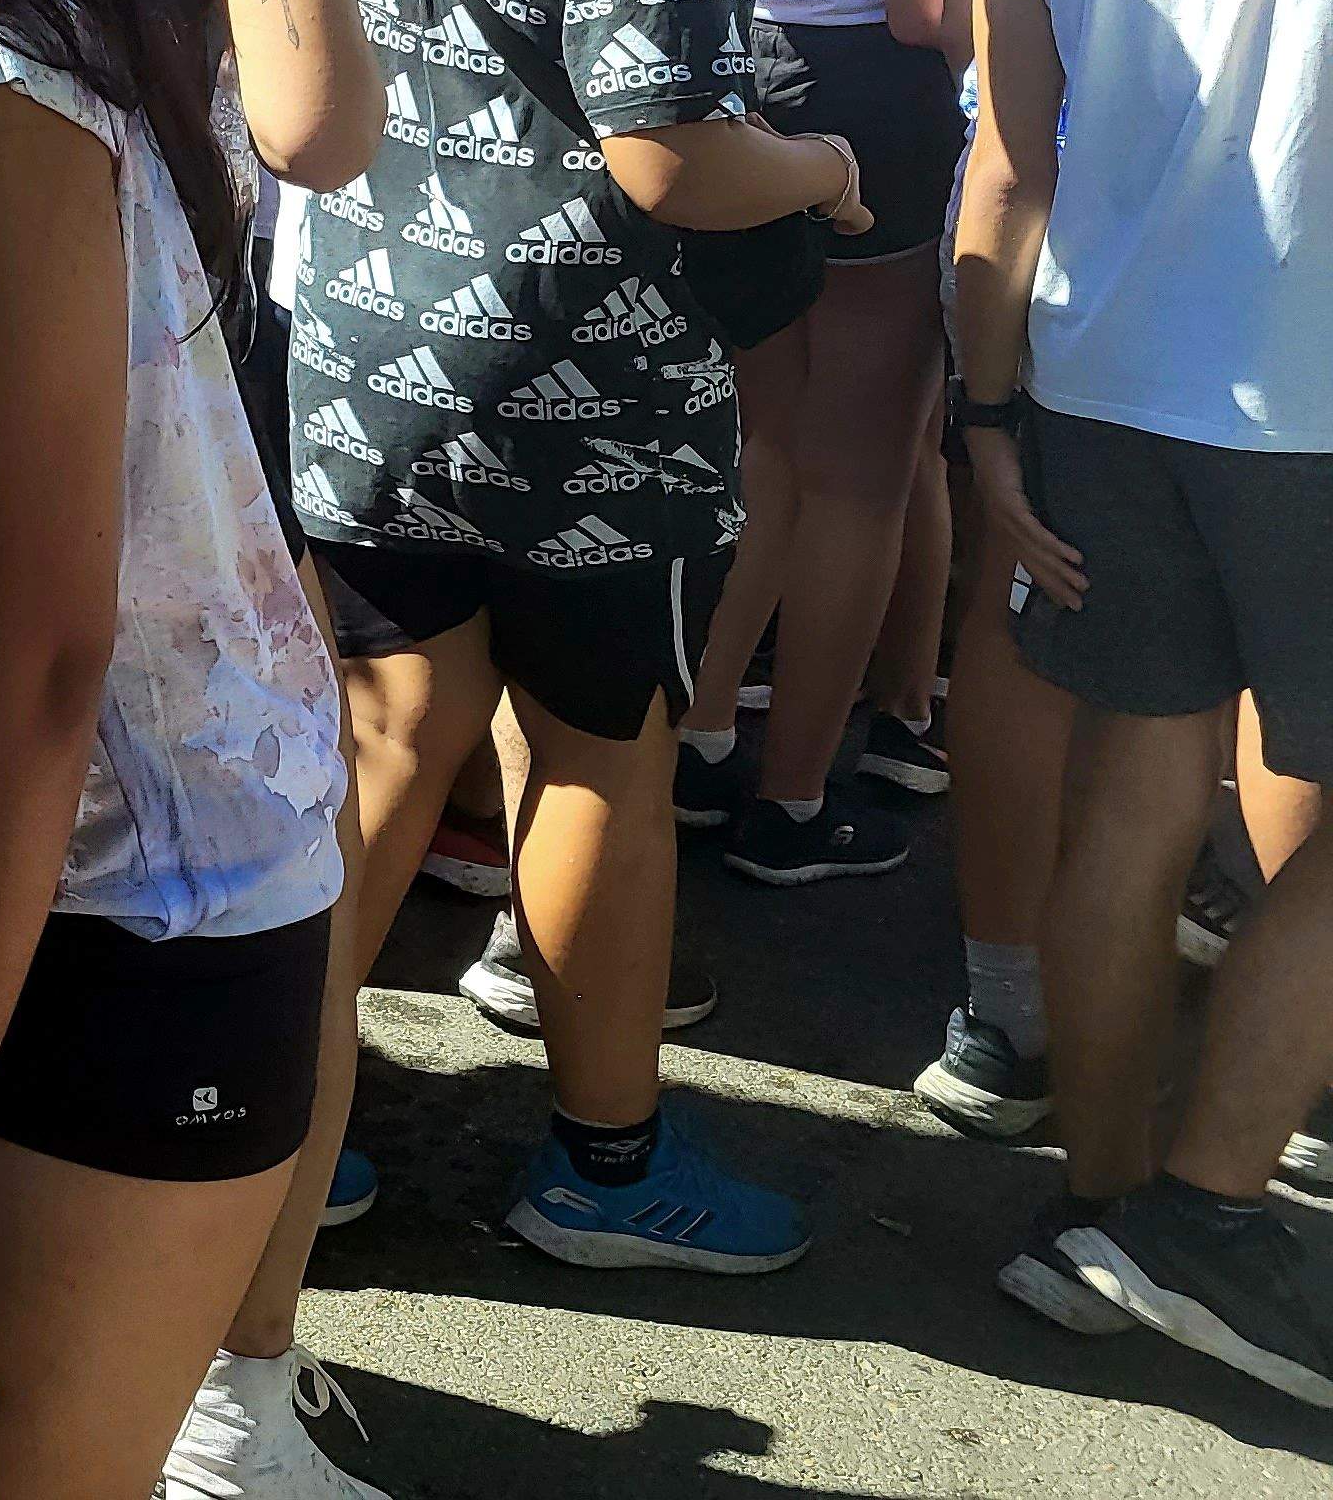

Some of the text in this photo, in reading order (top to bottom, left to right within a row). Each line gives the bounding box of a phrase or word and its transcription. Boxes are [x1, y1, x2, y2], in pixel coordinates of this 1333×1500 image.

[584, 62, 693, 99] adidas
[435, 135, 536, 168] adidas
[401, 221, 486, 260] adidas
[504, 239, 623, 266] adidas
[324, 278, 406, 322] adidas
[418, 306, 533, 342] adidas
[366, 371, 475, 414] adidas
[496, 397, 622, 422] adidas
[303, 420, 385, 467] adidas
[410, 459, 532, 493] adidas
[383, 520, 506, 554] adidas
[526, 541, 654, 570] adidas
